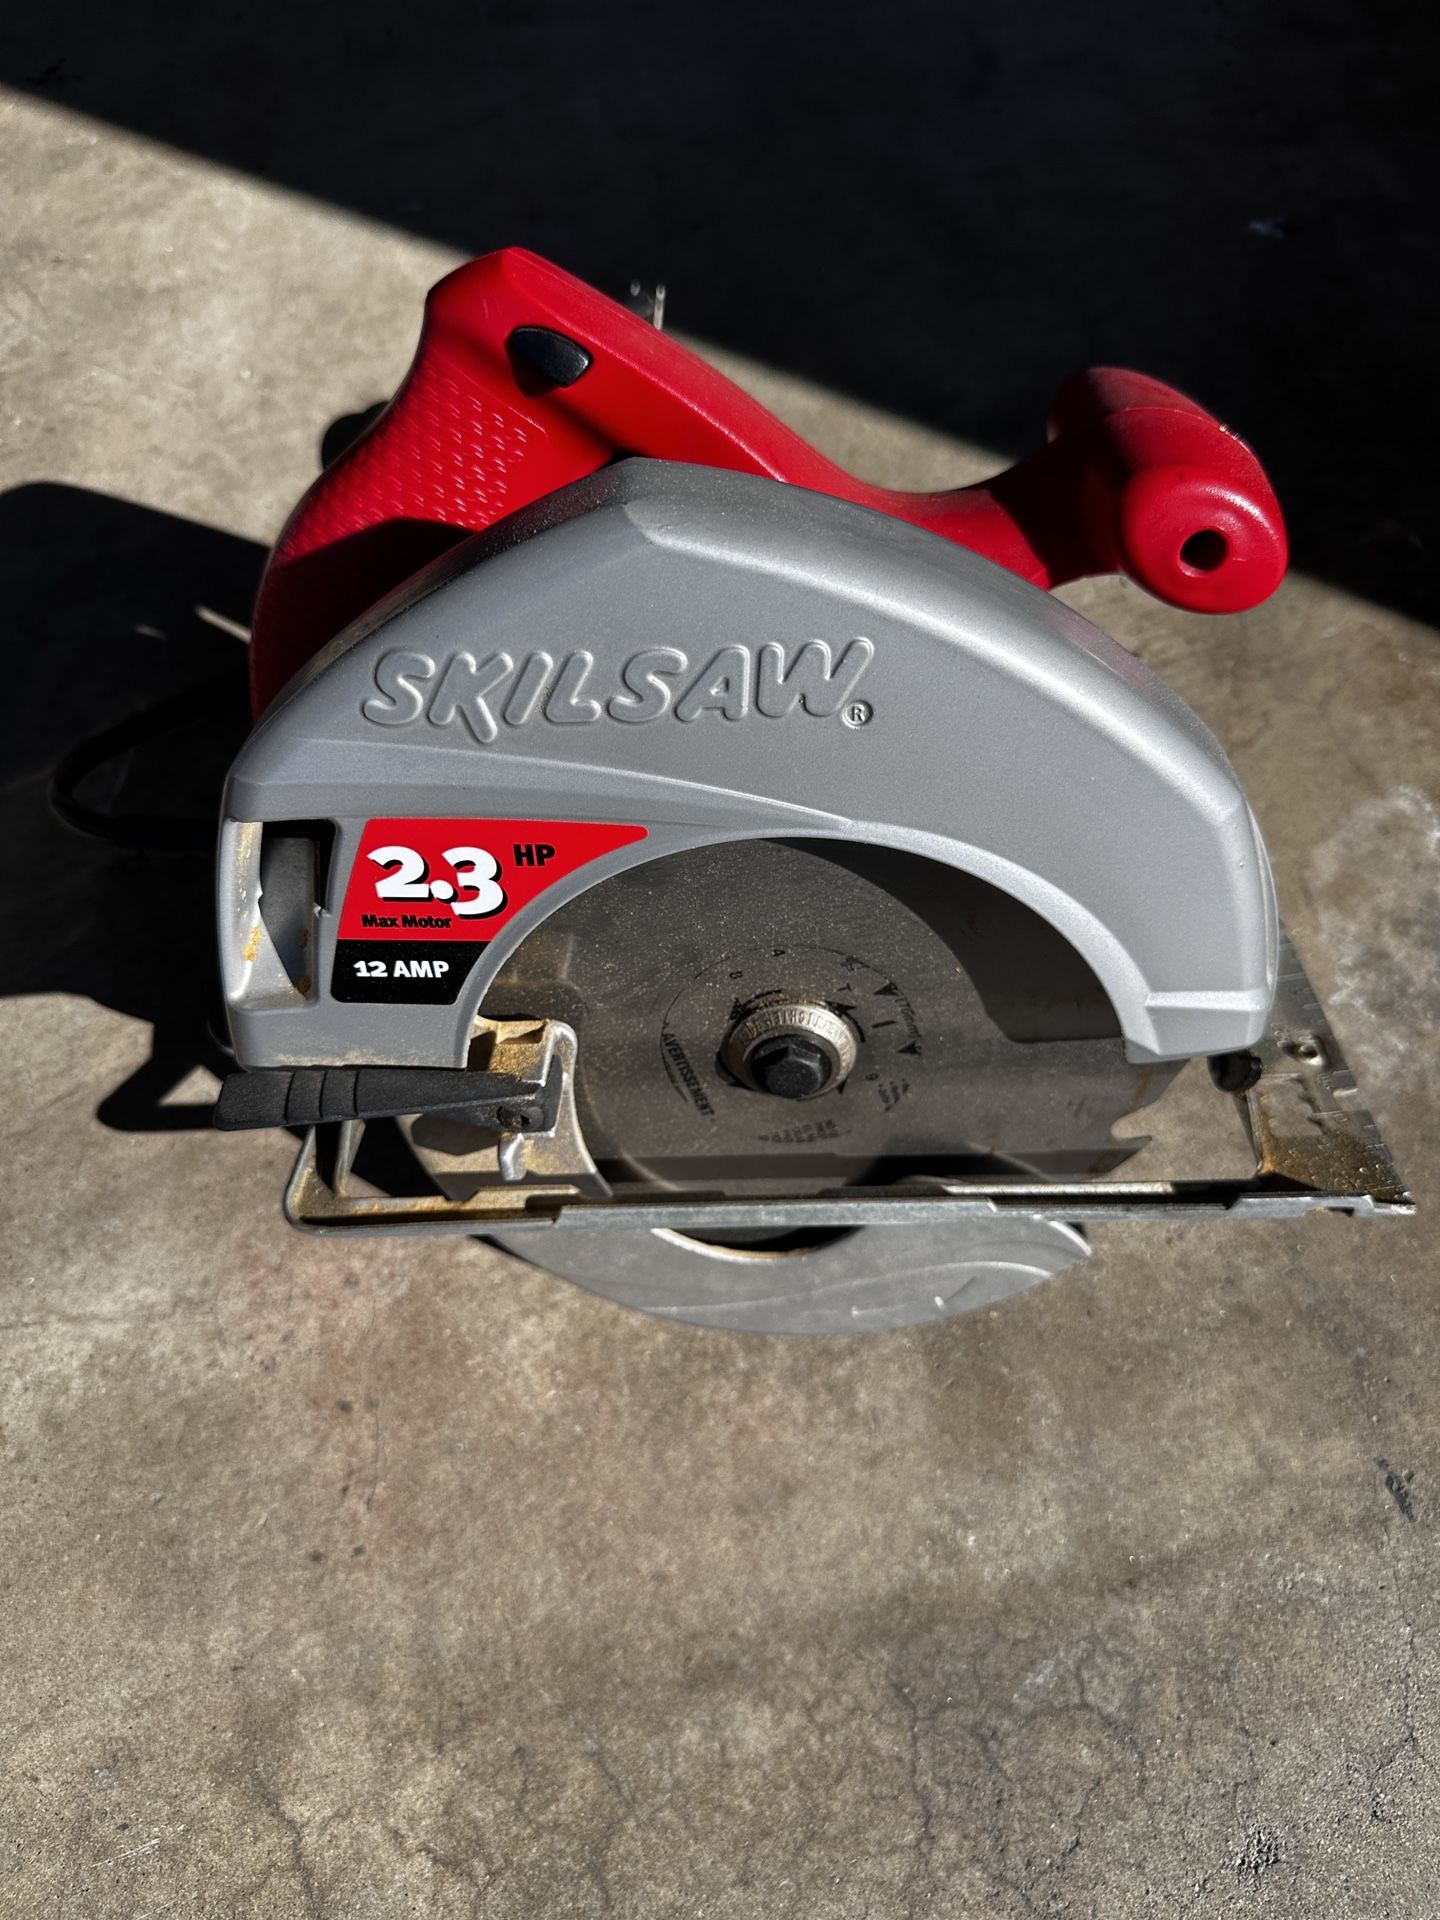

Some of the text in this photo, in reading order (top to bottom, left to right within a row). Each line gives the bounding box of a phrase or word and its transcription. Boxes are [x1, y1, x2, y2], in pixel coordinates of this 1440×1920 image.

[363, 636, 874, 744] SKILSAW
[513, 844, 555, 866] HP
[366, 845, 508, 919] 2.3
[361, 914, 452, 929] Max Motor
[353, 960, 449, 978] 12 AMP
[662, 1033, 716, 1116] AVERTISSEMENT
